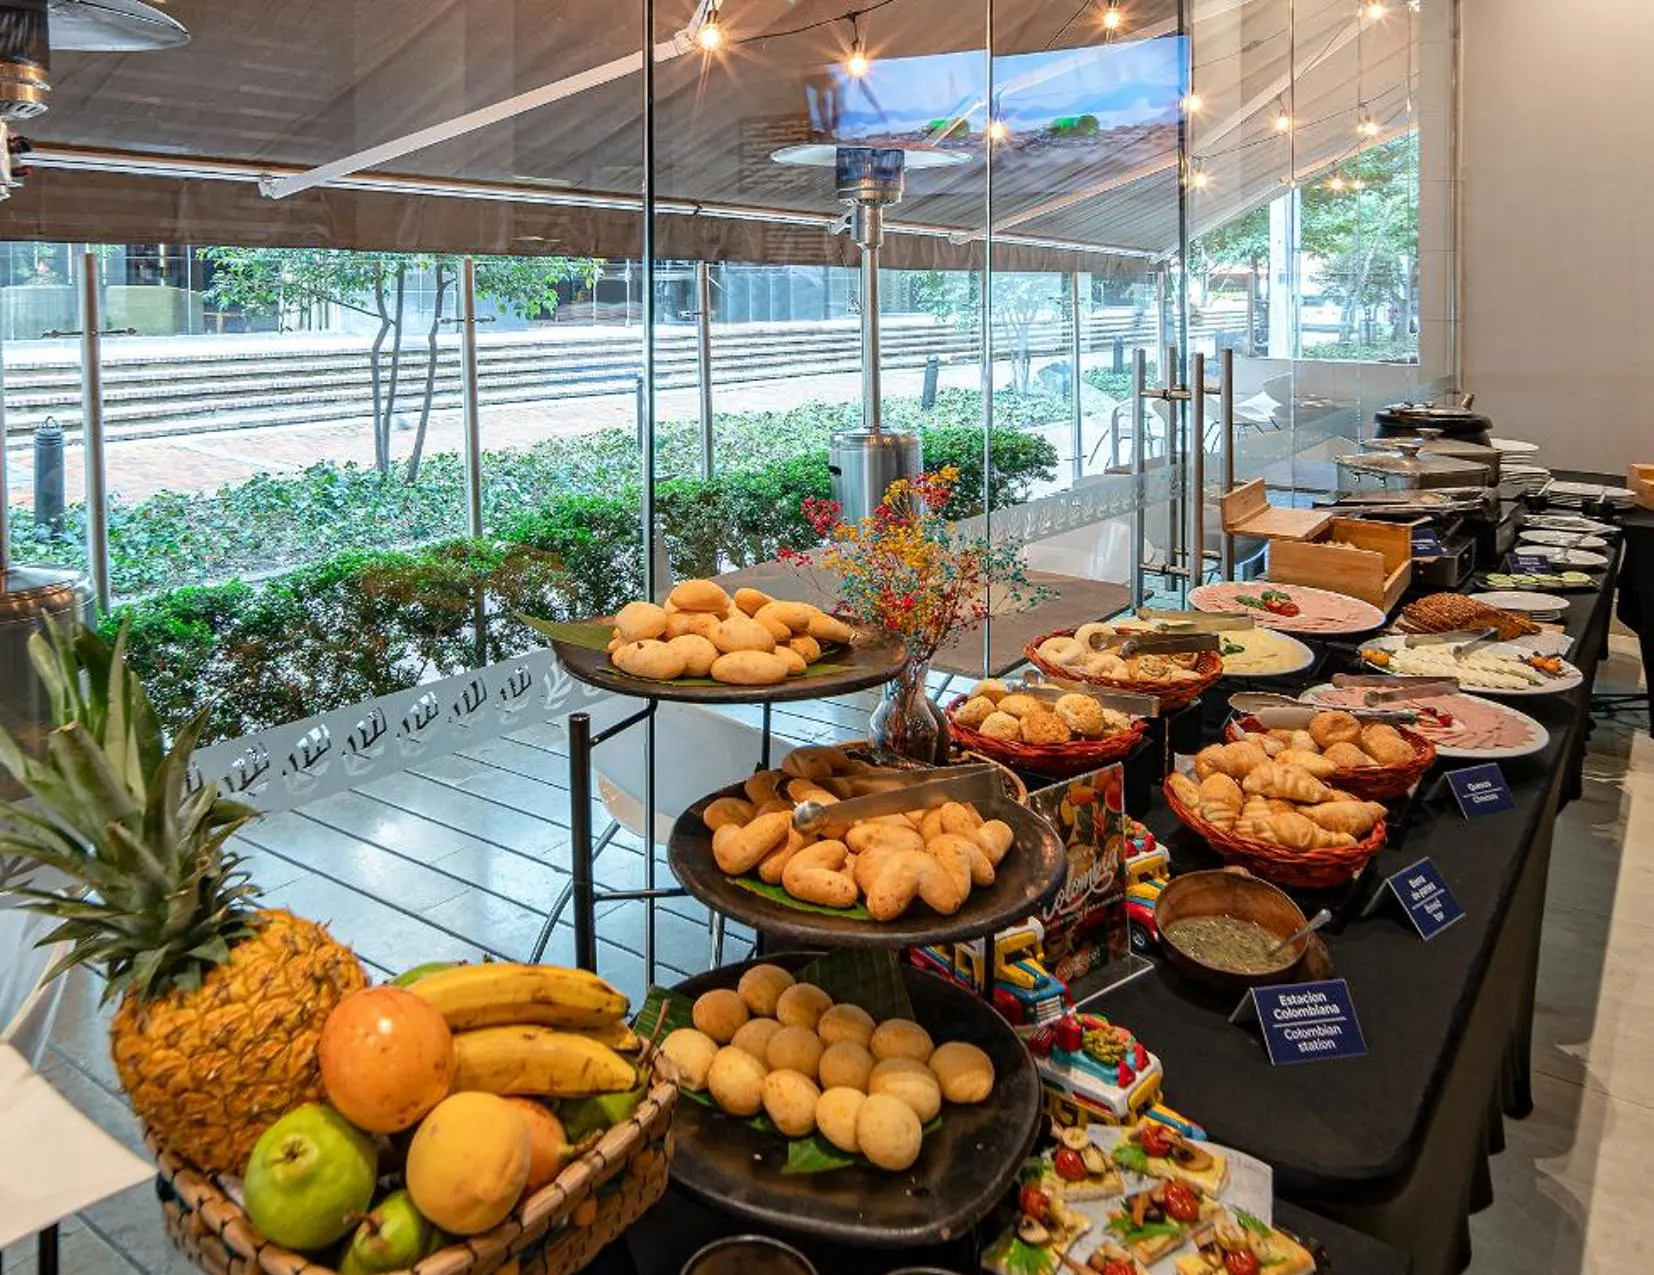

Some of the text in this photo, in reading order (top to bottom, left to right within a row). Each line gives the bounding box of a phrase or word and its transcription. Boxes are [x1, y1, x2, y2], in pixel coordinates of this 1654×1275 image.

[1272, 1003, 1340, 1020] Colombiana
[1283, 1023, 1343, 1040] Colombian
[1298, 1038, 1336, 1053] station
